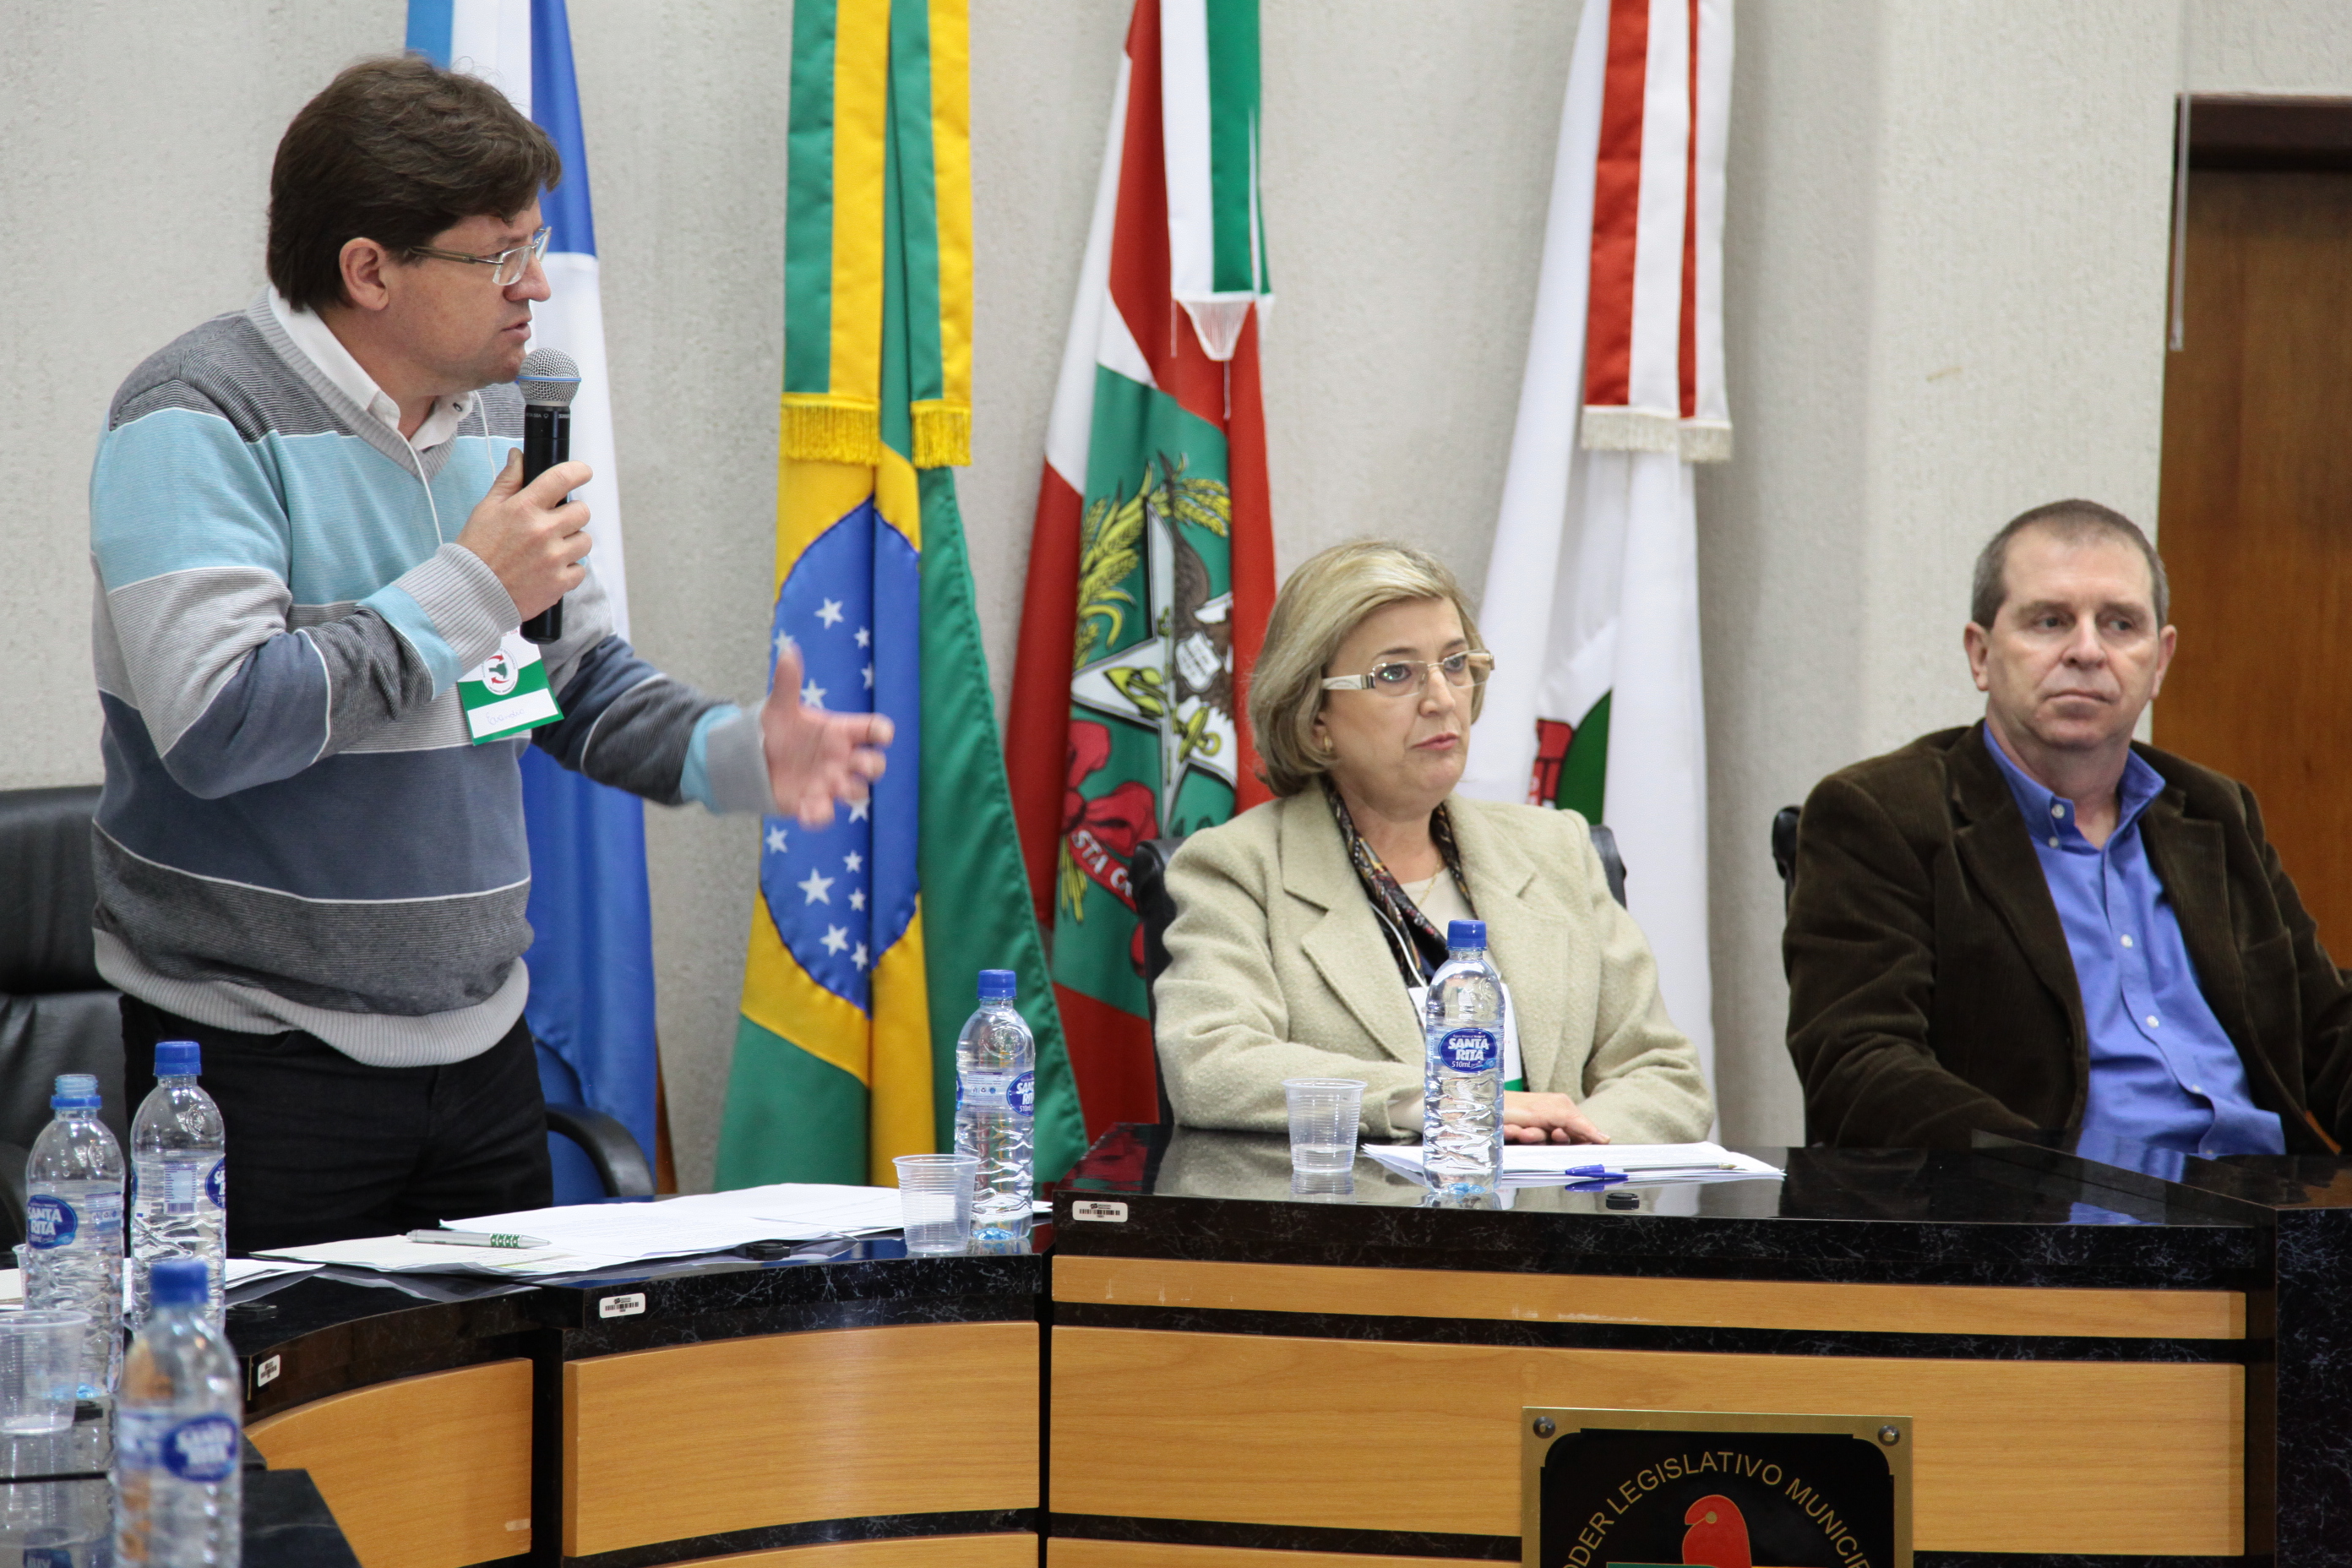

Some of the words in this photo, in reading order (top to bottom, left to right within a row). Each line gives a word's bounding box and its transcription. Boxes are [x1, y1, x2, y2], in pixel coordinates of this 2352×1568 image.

[1447, 1037, 1489, 1050] SANTA
[1455, 1048, 1484, 1061] RITA
[1563, 1512, 1614, 1568] DER
[1607, 1451, 1783, 1515] LEGISLATIVO
